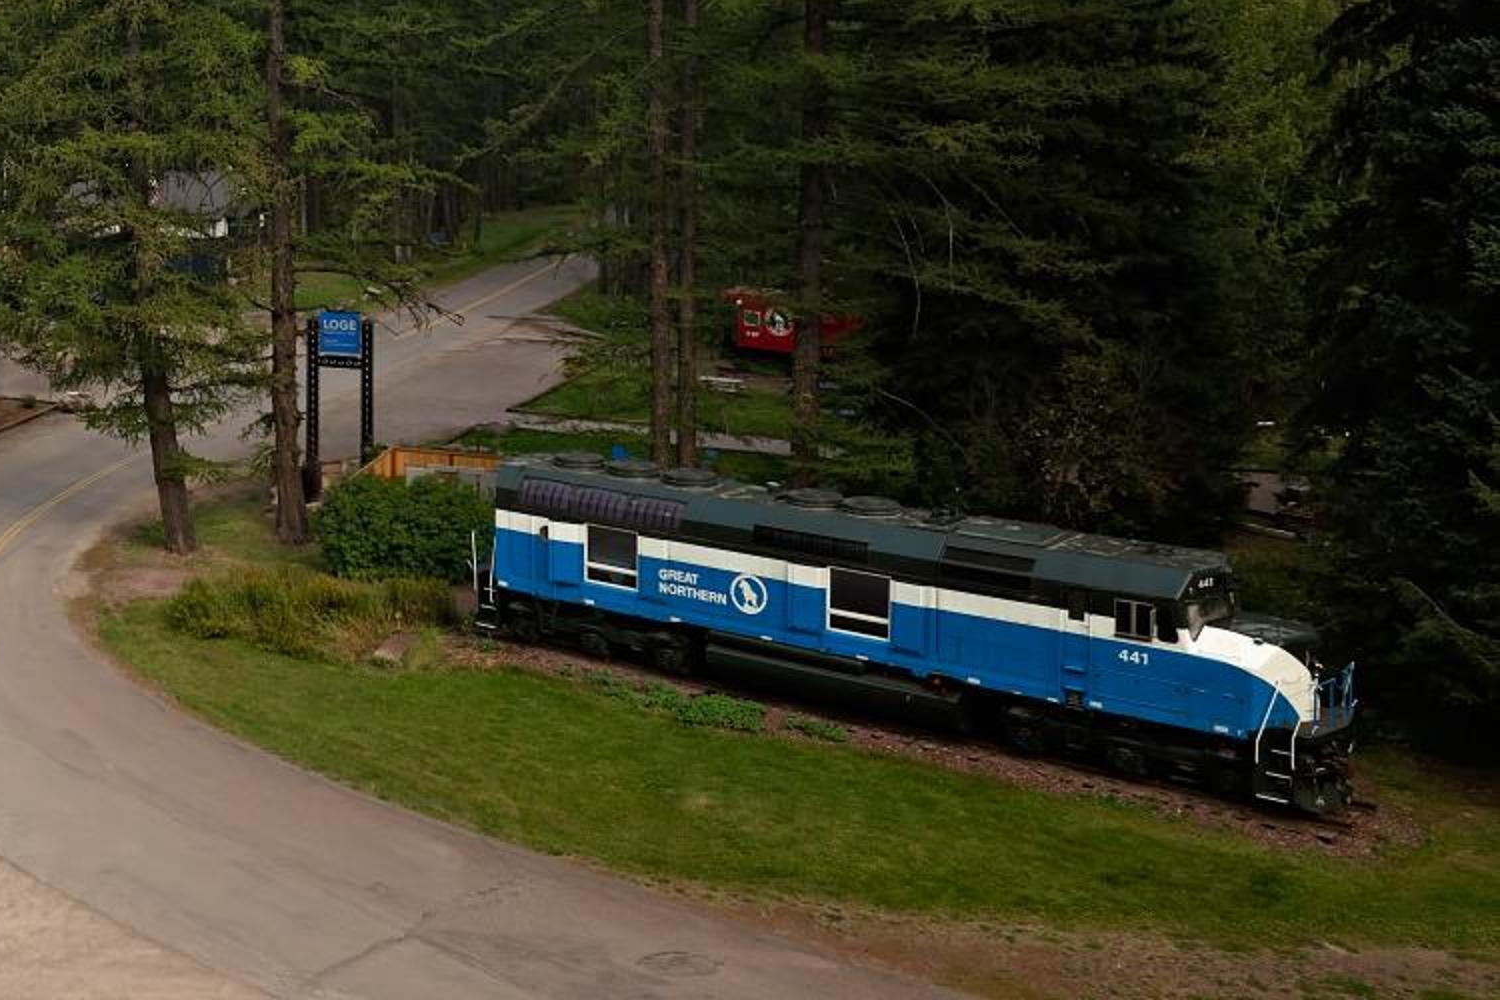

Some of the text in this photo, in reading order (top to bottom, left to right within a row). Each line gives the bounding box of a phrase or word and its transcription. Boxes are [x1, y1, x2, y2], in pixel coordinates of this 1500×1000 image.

[323, 319, 357, 331] LOGE
[659, 569, 698, 585] GREAT
[1198, 577, 1213, 588] 441
[659, 582, 727, 605] NORTHERN
[1118, 649, 1149, 665] 441
